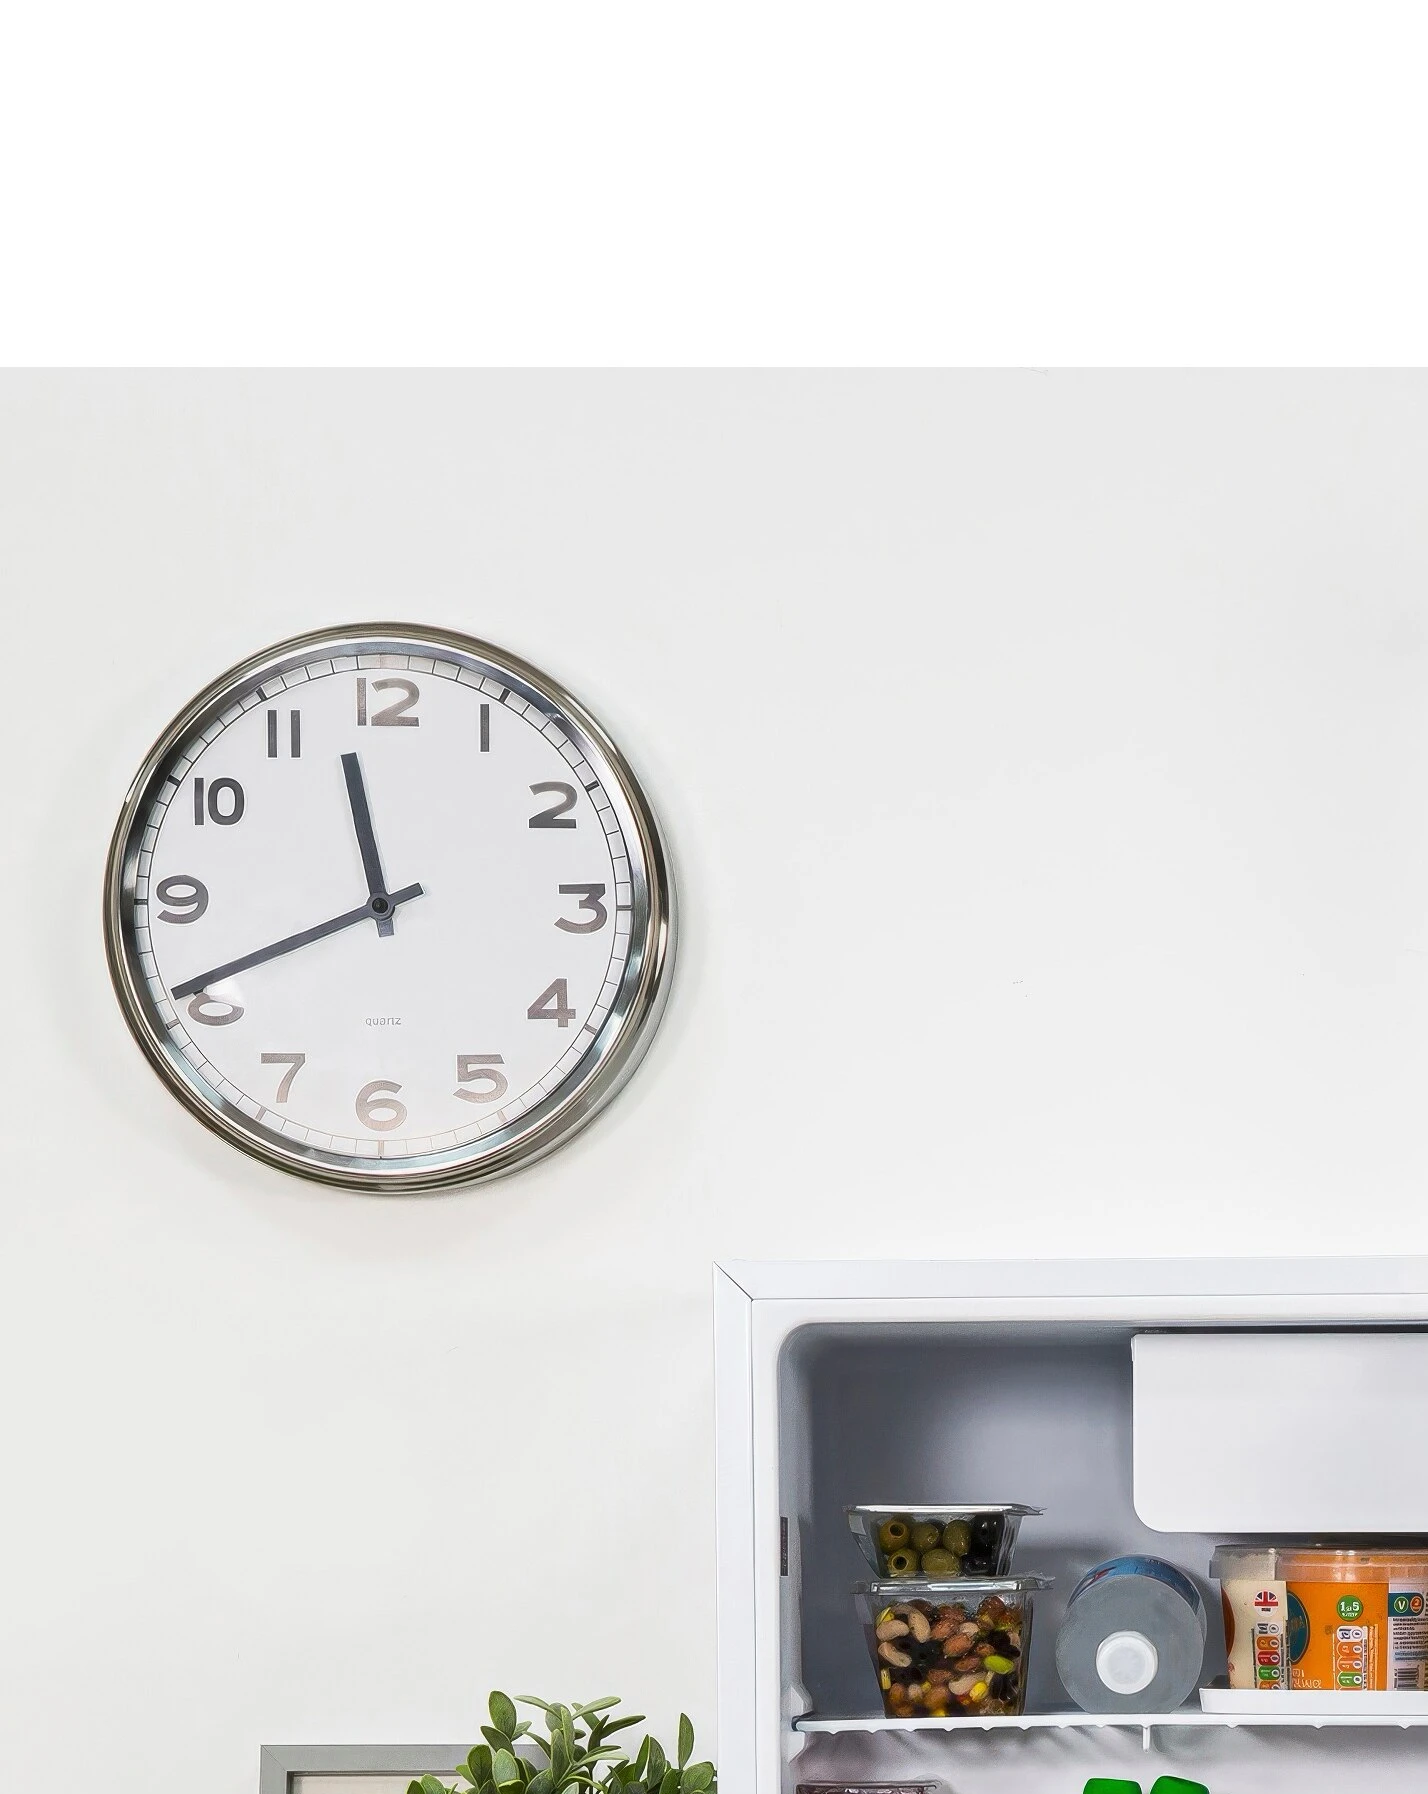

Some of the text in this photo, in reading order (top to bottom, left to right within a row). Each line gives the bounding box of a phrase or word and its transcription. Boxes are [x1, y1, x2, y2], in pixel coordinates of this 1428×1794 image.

[356, 677, 420, 727] 12
[267, 709, 301, 758] 11
[480, 703, 490, 752] 1
[193, 777, 245, 826] 10
[528, 781, 578, 828] 2
[156, 875, 209, 924] 9
[553, 883, 607, 934] 3
[527, 978, 576, 1027] 4
[260, 1052, 306, 1103] 7
[452, 1054, 508, 1103] 5
[355, 1079, 407, 1131] 6
